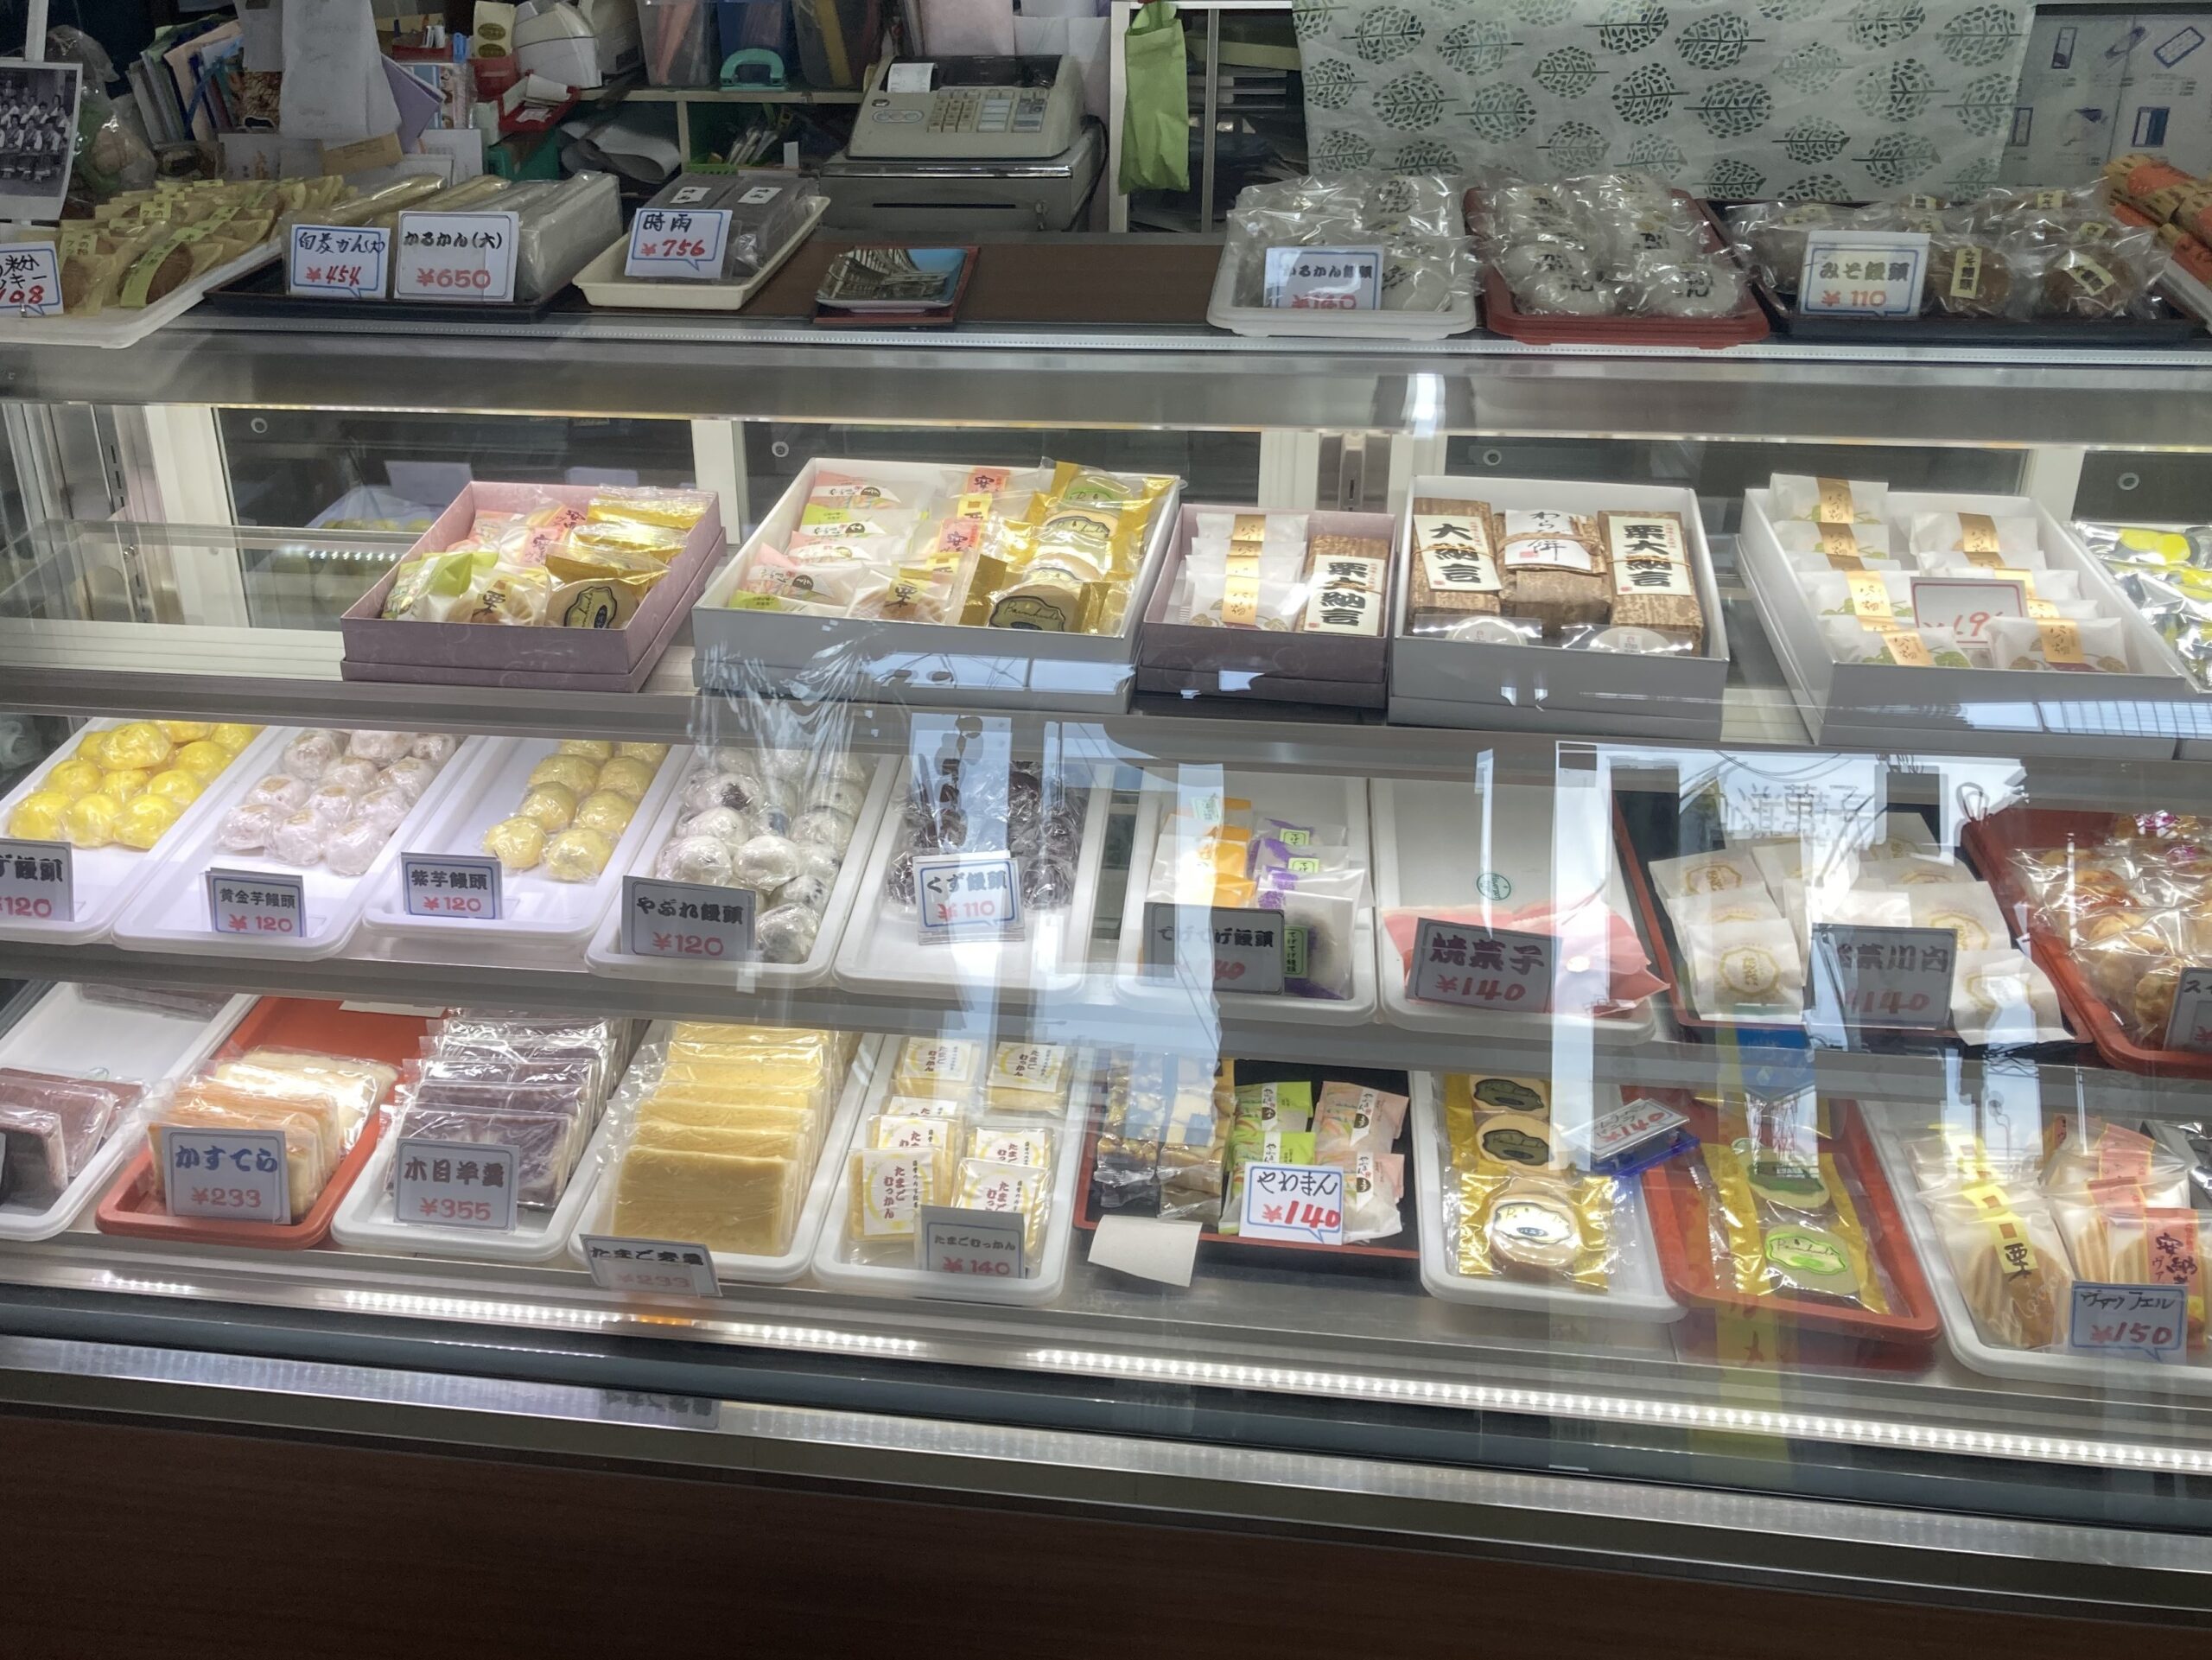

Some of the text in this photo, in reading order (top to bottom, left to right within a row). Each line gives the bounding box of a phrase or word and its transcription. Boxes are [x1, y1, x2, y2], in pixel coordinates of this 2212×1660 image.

[643, 213, 692, 232] 時雨
[640, 239, 706, 257] ¥756
[306, 264, 361, 286] ¥454
[416, 268, 492, 289] ¥650
[1819, 261, 1910, 283] みそ饅頭
[1821, 290, 1887, 308] ¥110
[1428, 523, 1482, 584] 大納言
[1623, 524, 1674, 588] 栗大納言
[410, 869, 488, 890] 紫芋饅頭
[926, 870, 1007, 894] くず饅頭
[219, 887, 296, 909] 黄金芋饅頭
[423, 896, 482, 913] ¥120
[636, 896, 743, 925] やぶれ饅頭
[937, 900, 995, 920] ¥110
[228, 913, 293, 932] ¥120
[652, 932, 724, 957] ¥120
[1430, 932, 1545, 976] 焼菓子
[1435, 975, 1527, 1002] ¥140
[175, 1145, 278, 1173] かすてら
[894, 1166, 906, 1201] たまご
[1257, 1171, 1338, 1197] やわまん
[191, 1186, 262, 1208] ¥233
[883, 1175, 894, 1219] むっかん
[420, 1198, 492, 1221] ¥355
[1262, 1200, 1342, 1228] ¥140
[934, 1235, 1016, 1251] たまごむっかん
[943, 1256, 1010, 1275] ¥140
[2090, 1322, 2173, 1345] ¥150
